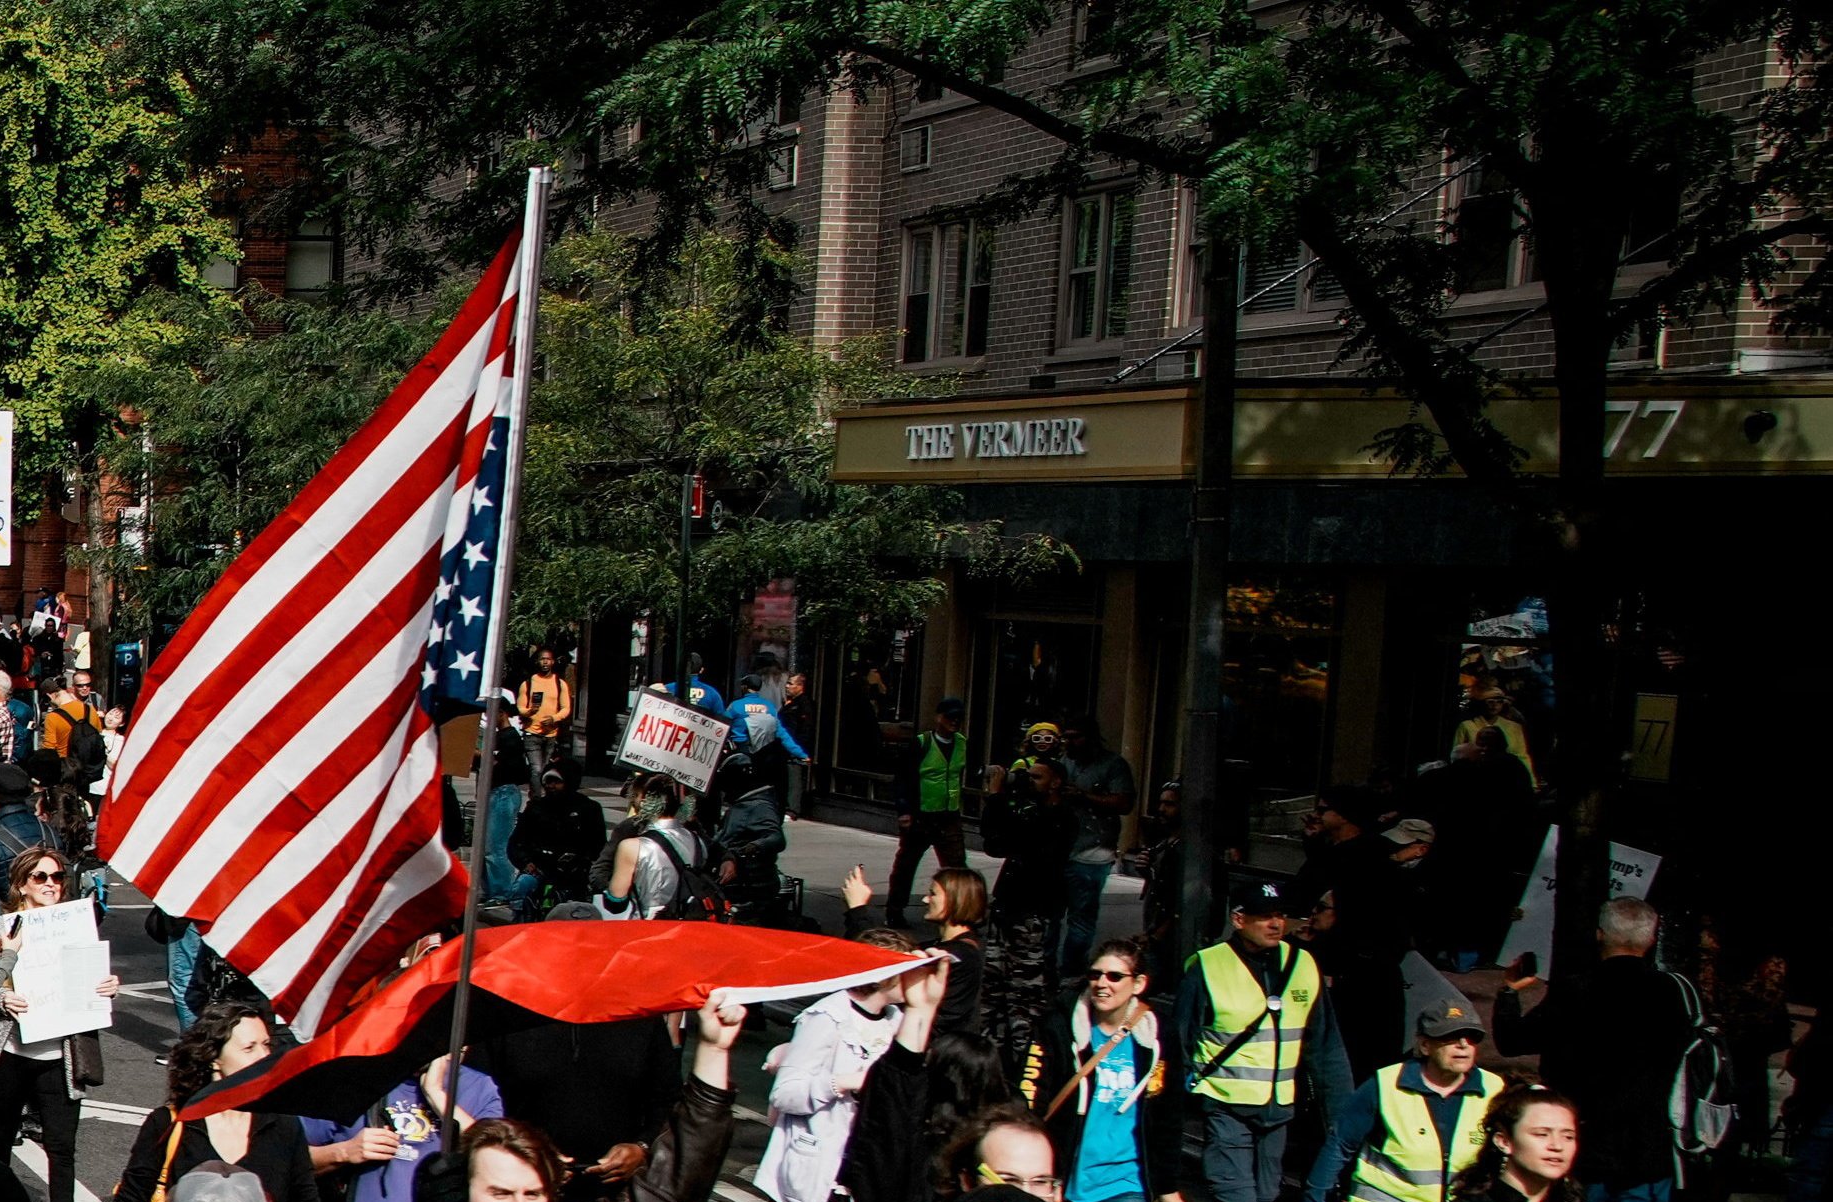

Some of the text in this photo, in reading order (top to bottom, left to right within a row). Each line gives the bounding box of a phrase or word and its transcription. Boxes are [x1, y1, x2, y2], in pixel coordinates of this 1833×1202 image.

[904, 418, 1087, 461] THE VERMEER
[657, 701, 669, 710] IF
[701, 716, 717, 729] NOT
[1639, 718, 1670, 755] 77
[624, 750, 643, 762] WHAT
[643, 757, 661, 770] DOES
